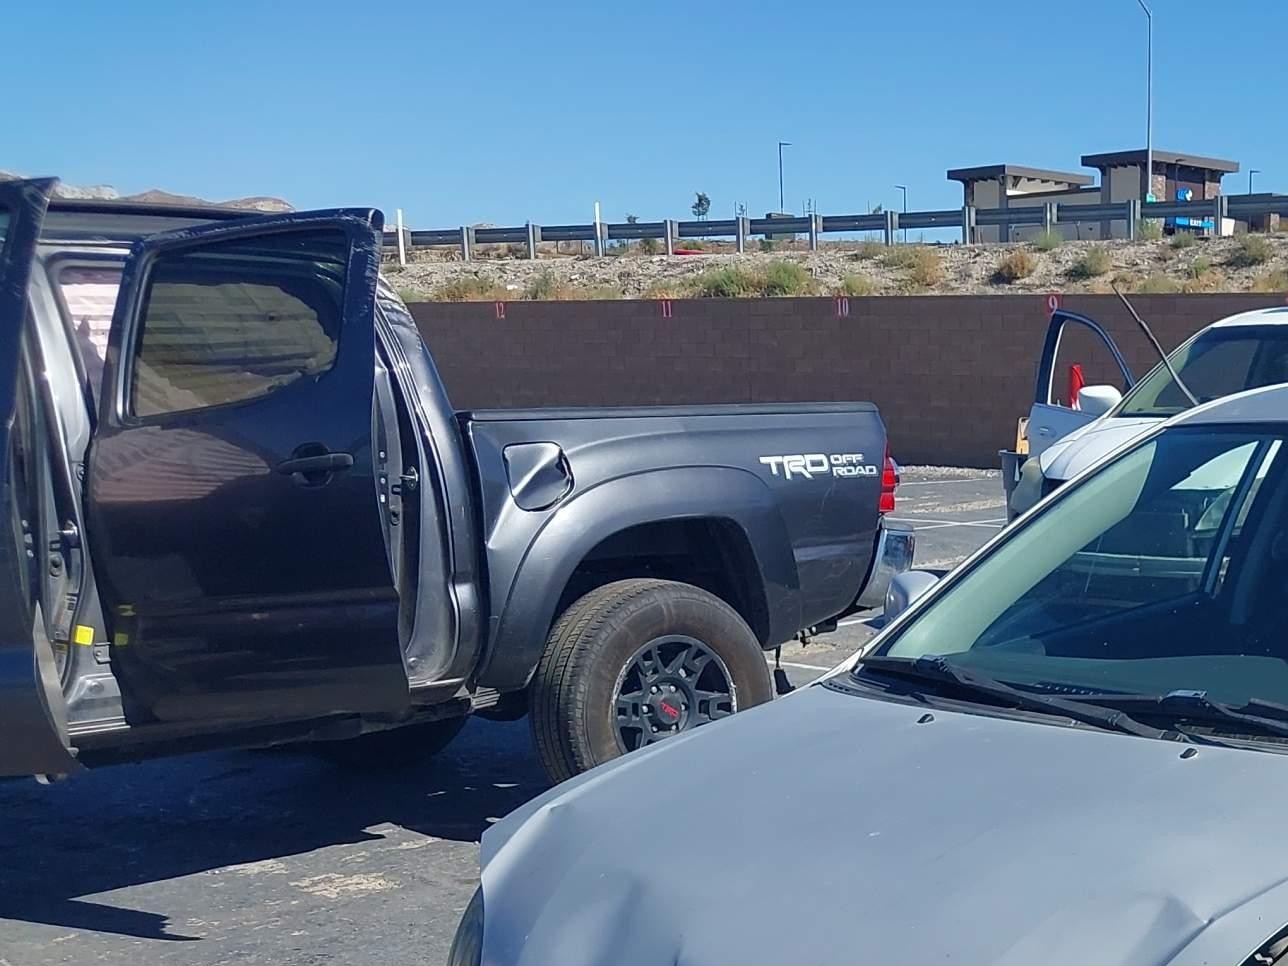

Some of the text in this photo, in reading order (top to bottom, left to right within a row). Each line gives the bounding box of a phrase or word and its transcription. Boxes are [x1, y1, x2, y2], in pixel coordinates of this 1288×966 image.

[661, 300, 672, 318] 11
[836, 298, 849, 317] 10
[1048, 295, 1059, 315] 9
[759, 453, 829, 480] TRD
[830, 453, 864, 465] OFF
[832, 465, 879, 478] ROAD
